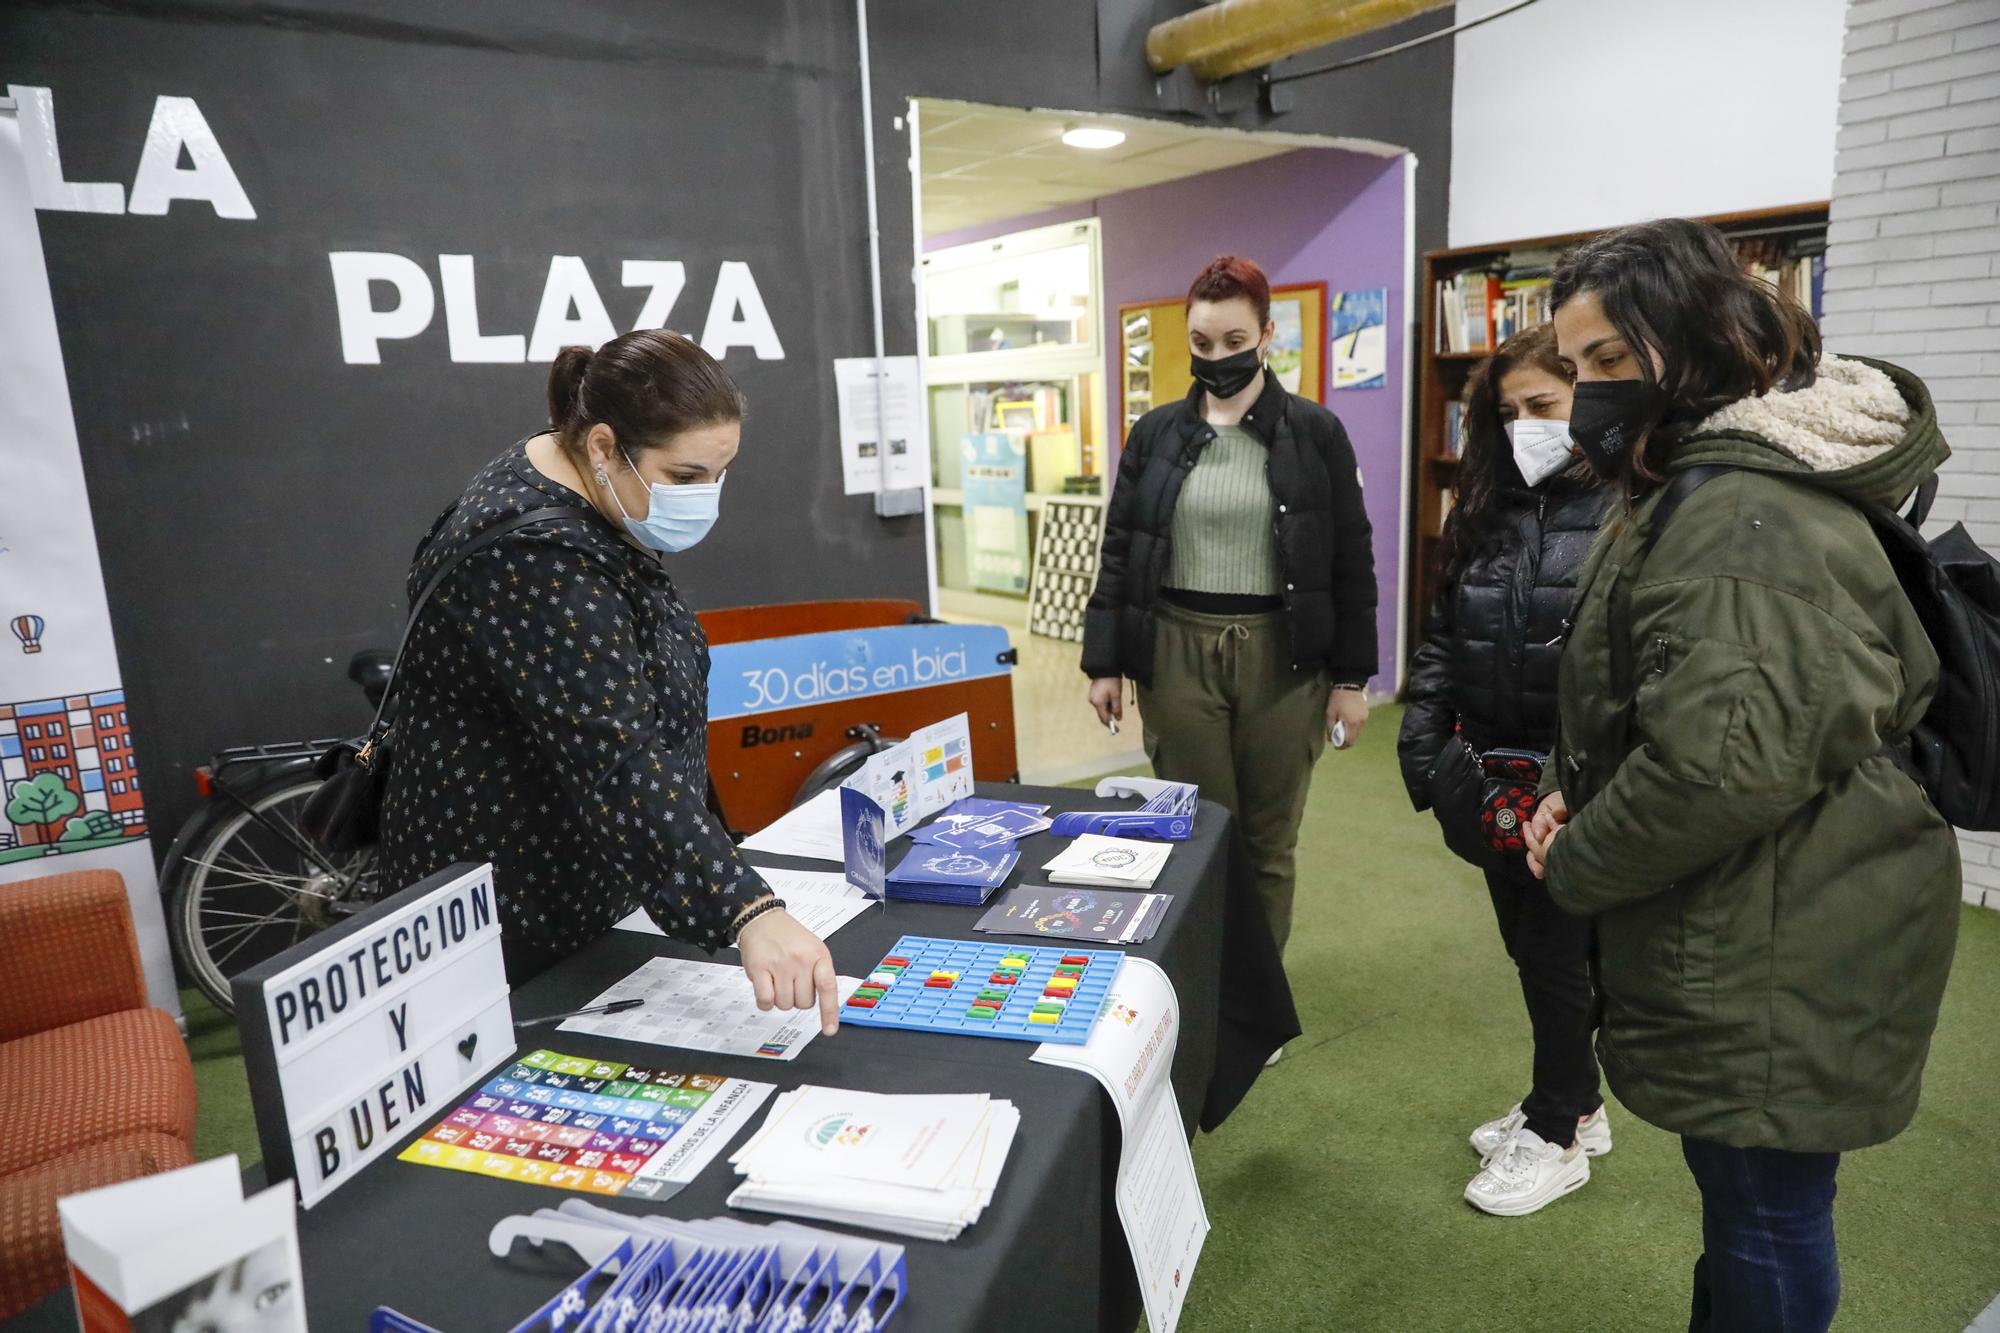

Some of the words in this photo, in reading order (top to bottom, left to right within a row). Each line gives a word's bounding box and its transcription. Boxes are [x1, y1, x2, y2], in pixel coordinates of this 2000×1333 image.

[7, 84, 257, 219] LA
[329, 251, 784, 364] PLAZA
[742, 668, 789, 708] 30
[794, 661, 868, 700] días
[872, 662, 908, 689] en
[912, 643, 967, 682] bici
[275, 883, 490, 1046] PROTECCION
[389, 1002, 407, 1052] Y
[315, 1061, 426, 1180] BUEN
[654, 1137, 699, 1176] DERECHOS
[693, 1126, 709, 1138] DE
[704, 1115, 719, 1126] LA
[713, 1083, 749, 1116] INFANCIA
